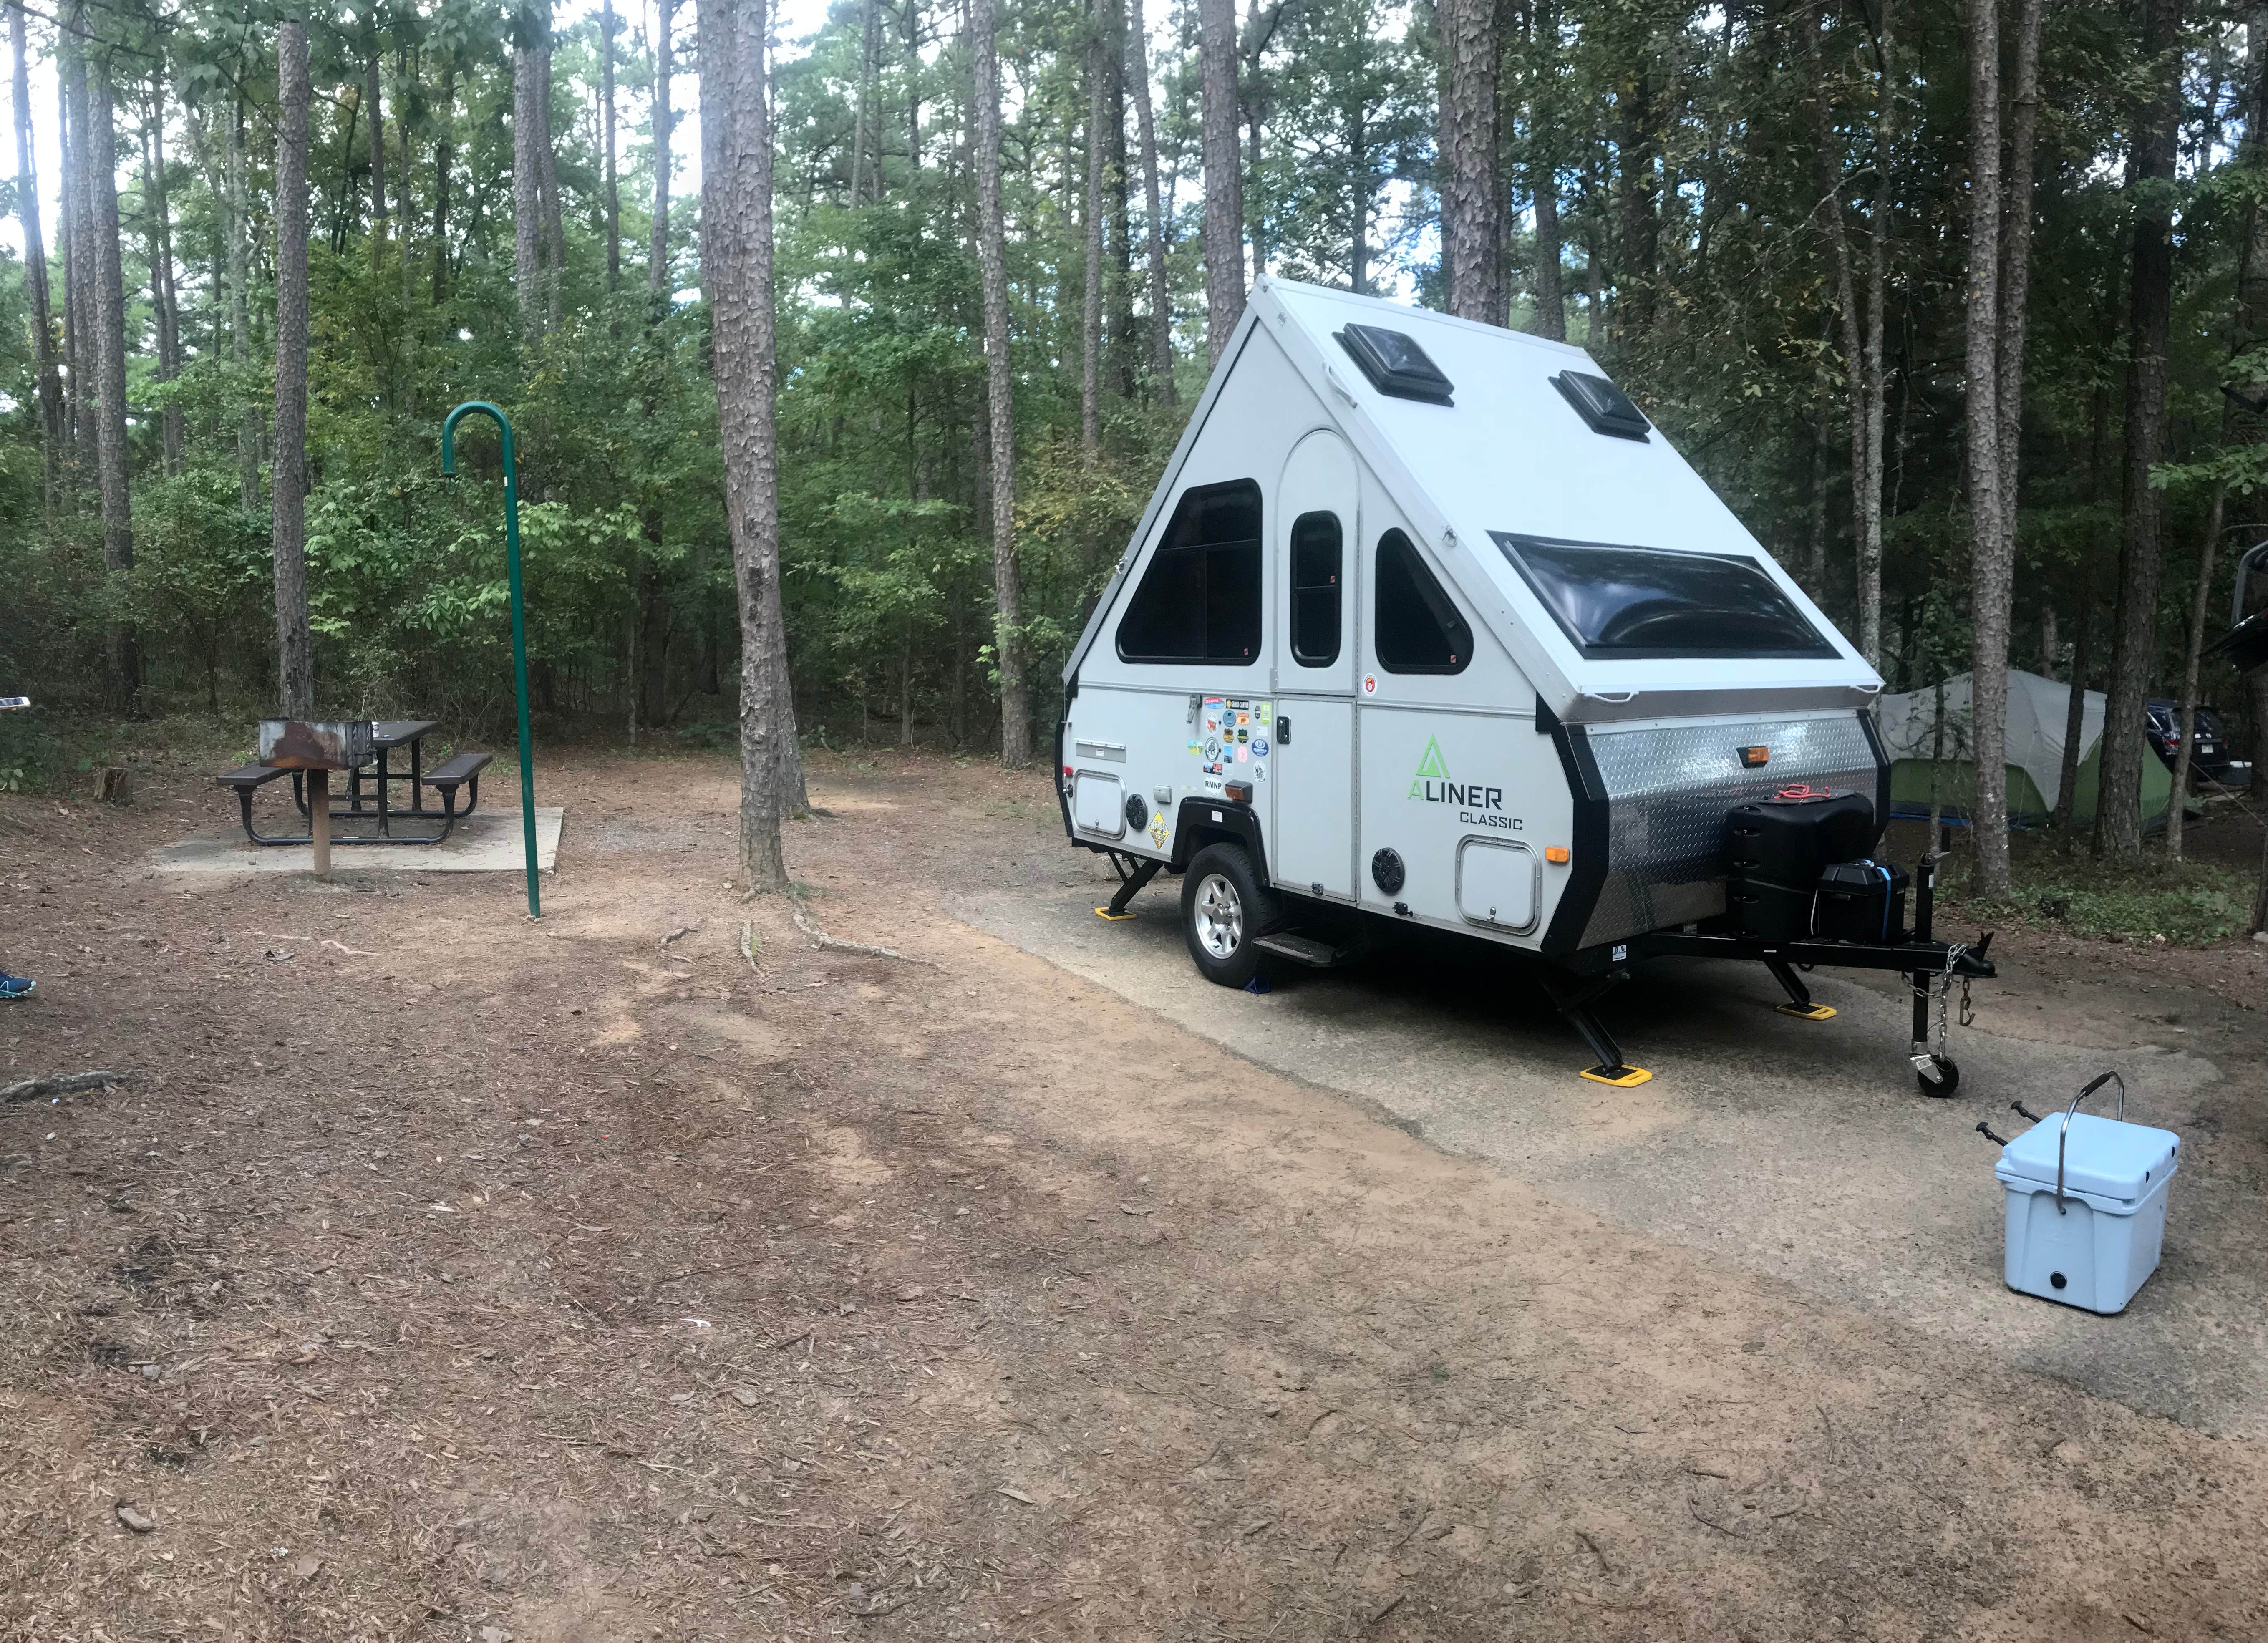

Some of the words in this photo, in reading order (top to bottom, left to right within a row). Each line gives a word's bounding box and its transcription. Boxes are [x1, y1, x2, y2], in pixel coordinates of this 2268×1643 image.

[1205, 780, 1221, 789] RMNP
[1407, 779, 1502, 810] ALINER
[1158, 821, 1167, 832] ROAD
[1460, 812, 1522, 830] CLASSIC
